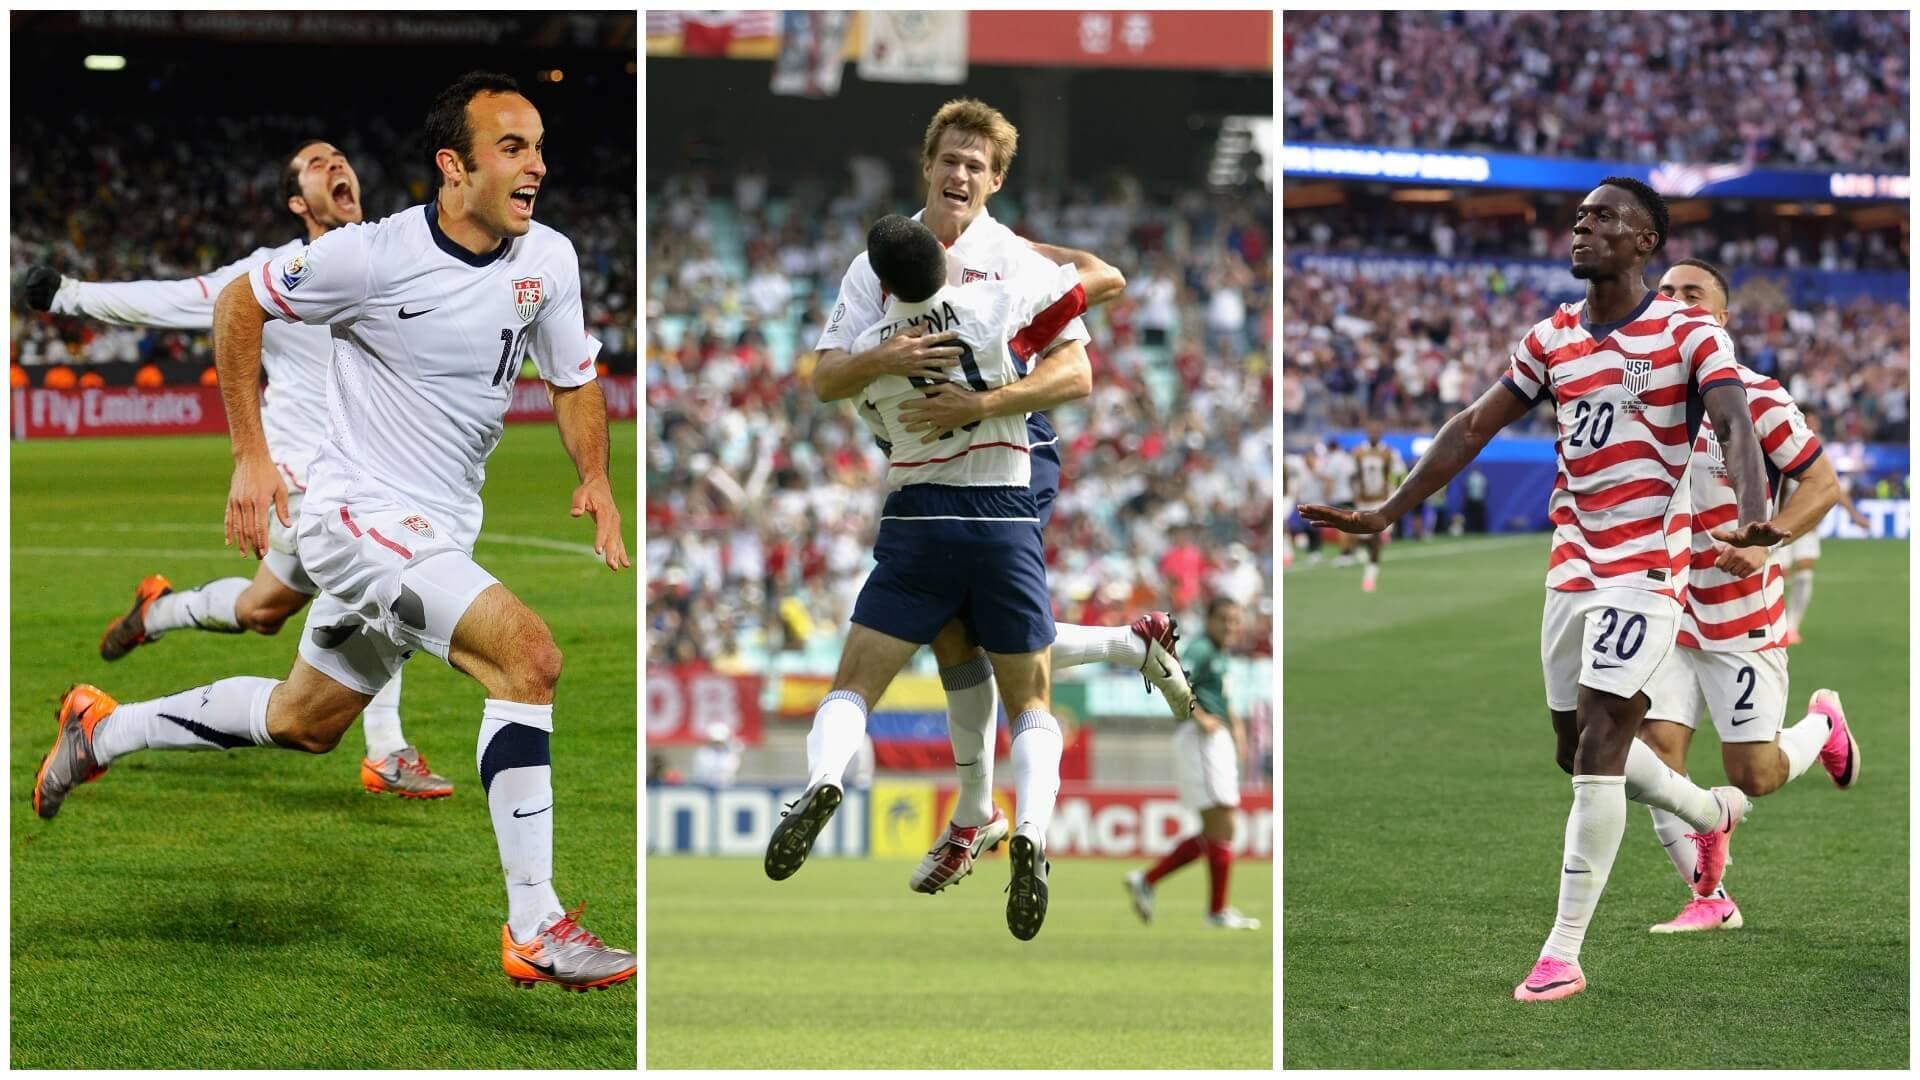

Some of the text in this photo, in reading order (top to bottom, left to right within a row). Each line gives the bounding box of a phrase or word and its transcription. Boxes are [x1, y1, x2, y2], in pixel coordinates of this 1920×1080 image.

[1626, 360, 1651, 375] USA
[32, 387, 203, 434] Fly Emirates
[1569, 400, 1614, 449] 20
[1592, 608, 1647, 660] 20
[1734, 665, 1757, 710] 2
